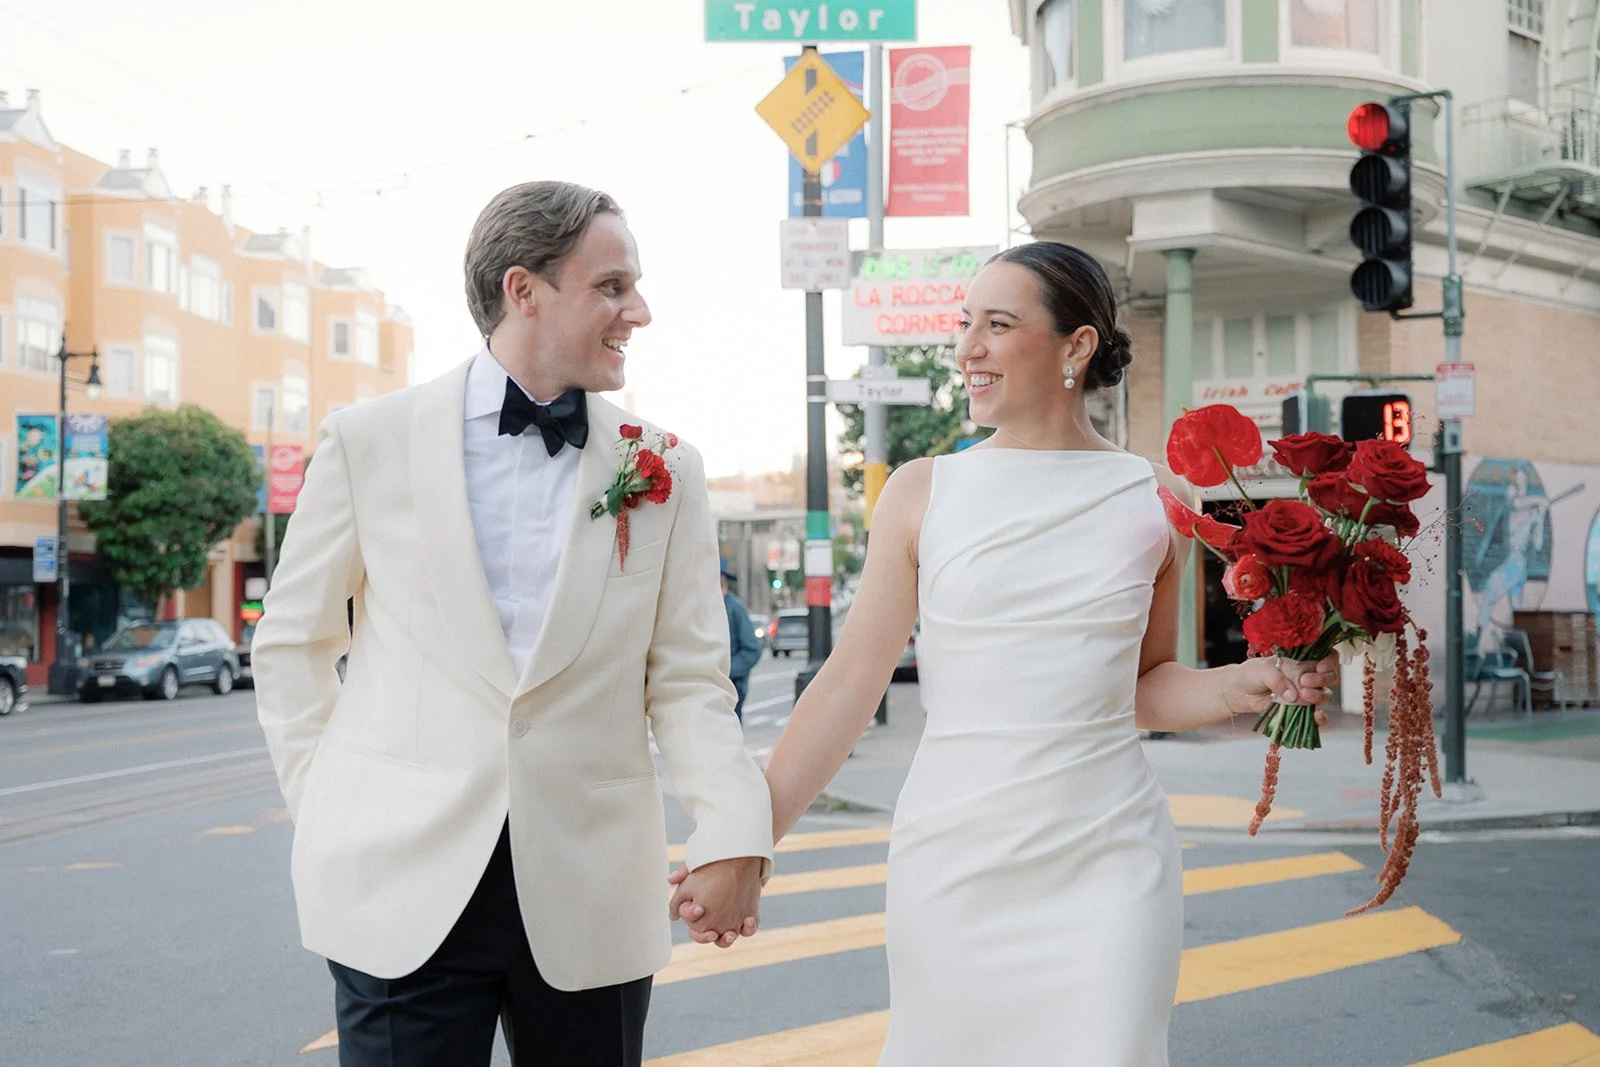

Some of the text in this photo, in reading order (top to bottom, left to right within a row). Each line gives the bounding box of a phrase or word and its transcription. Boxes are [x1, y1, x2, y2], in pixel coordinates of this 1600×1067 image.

[734, 3, 885, 38] Taylor
[854, 282, 968, 308] LA ROCCA
[876, 311, 965, 334] CORNER
[858, 384, 903, 401] Taylor
[1383, 400, 1411, 443] 13
